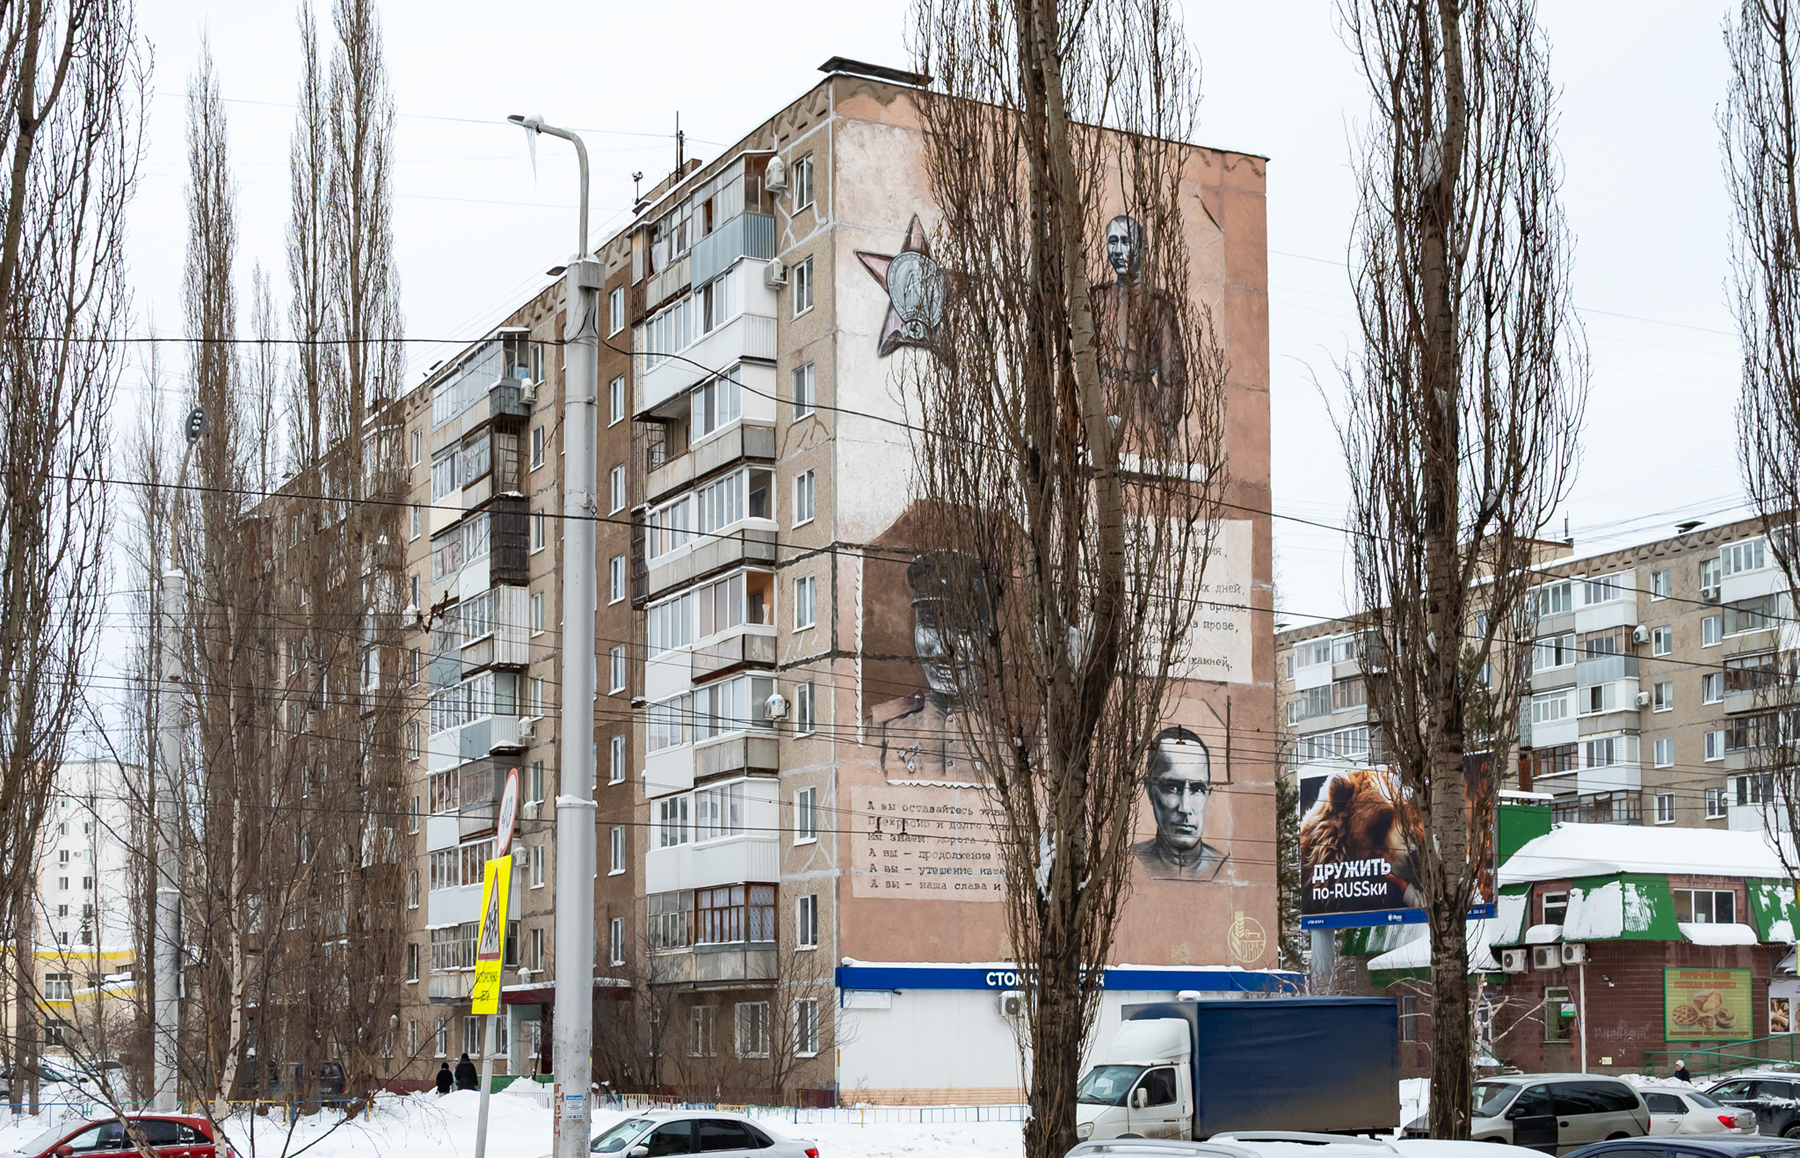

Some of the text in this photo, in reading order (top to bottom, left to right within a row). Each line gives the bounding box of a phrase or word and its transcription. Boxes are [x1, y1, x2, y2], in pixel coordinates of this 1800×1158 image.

[1215, 584, 1245, 595] дней,
[1193, 619, 1239, 633] в прозе,
[867, 801, 875, 811] А
[881, 803, 896, 811] вы
[902, 804, 974, 816] оставайтесь
[868, 848, 877, 857] А
[883, 848, 898, 857] вы
[918, 850, 991, 860] продолжение
[869, 863, 878, 873] А
[884, 864, 899, 873] вы
[919, 867, 973, 876] утешение
[1312, 858, 1391, 884] ДРУЖИТЬ
[870, 878, 879, 888] А
[885, 880, 900, 889] вы
[919, 882, 947, 890] наша
[954, 882, 988, 891] слава
